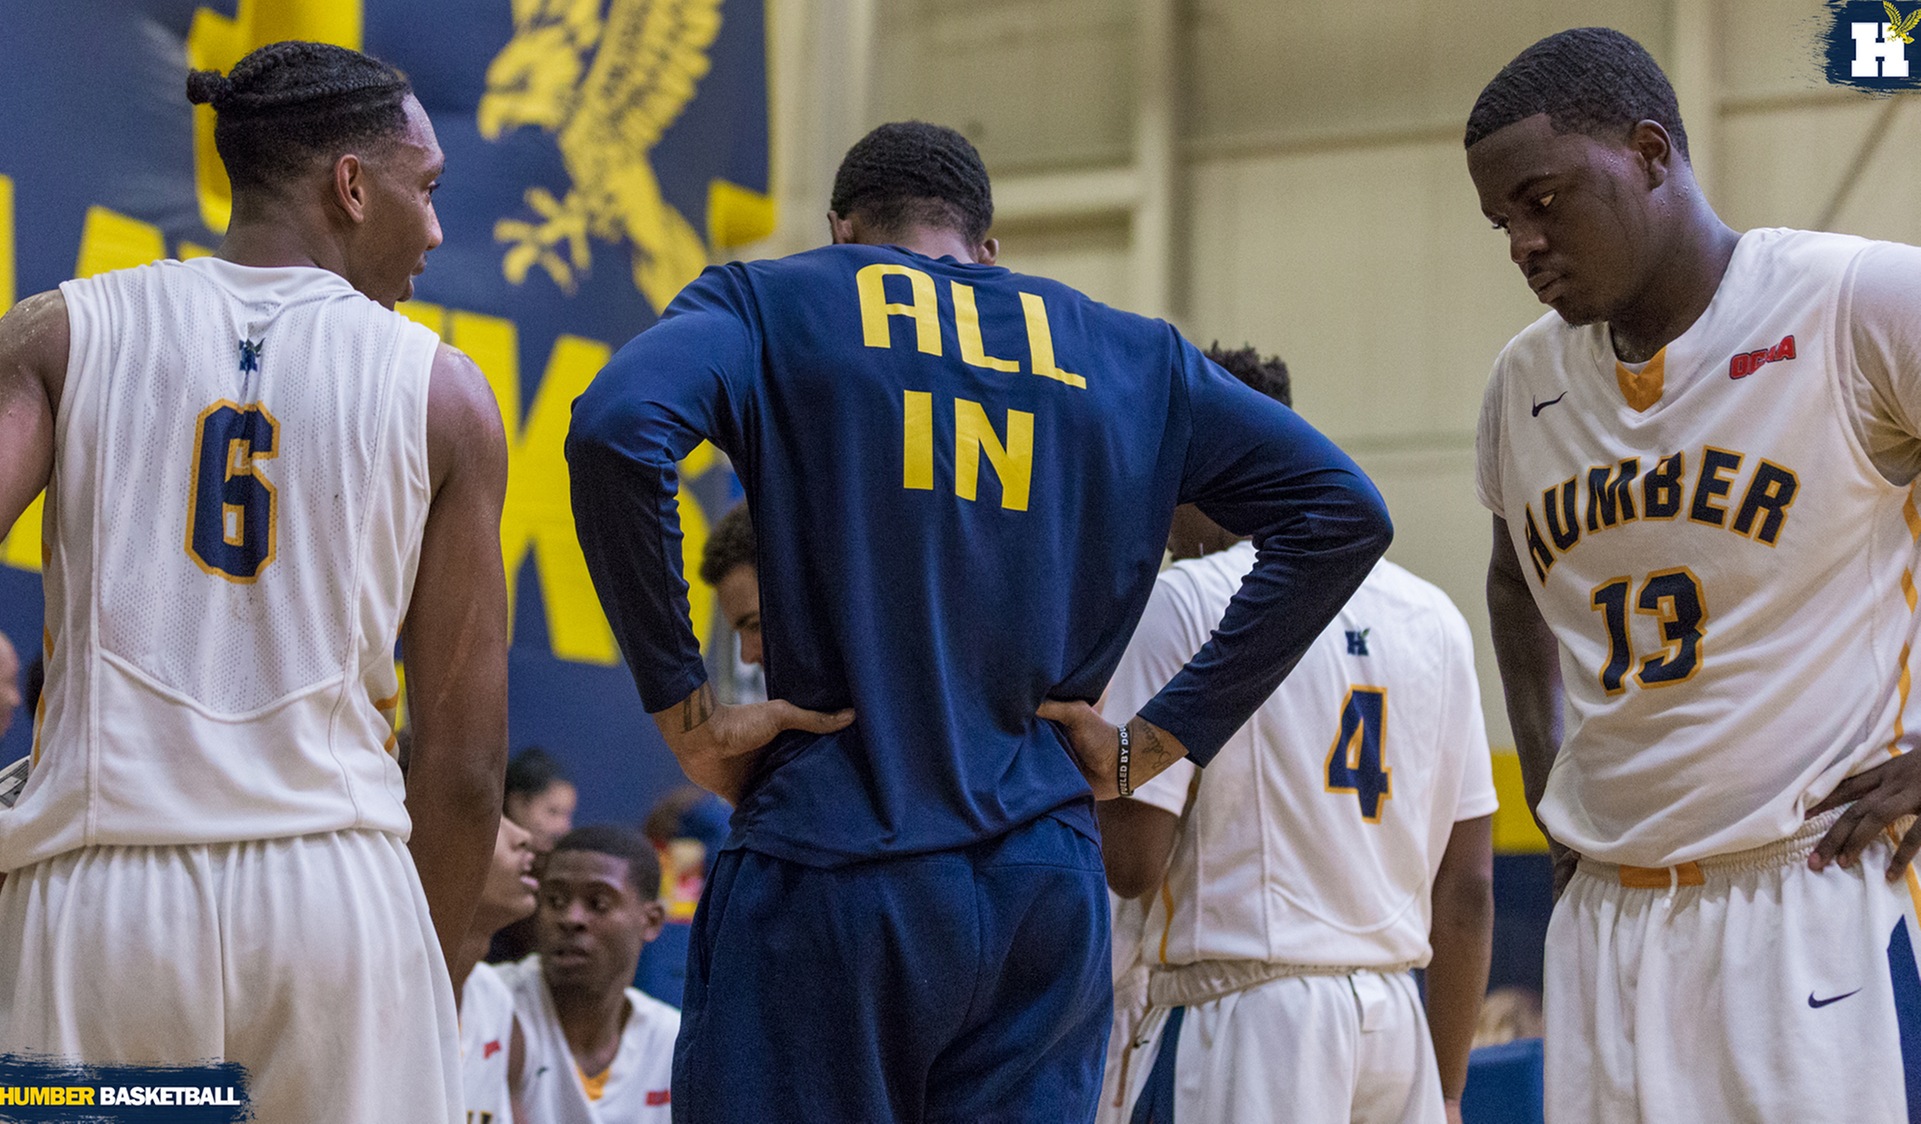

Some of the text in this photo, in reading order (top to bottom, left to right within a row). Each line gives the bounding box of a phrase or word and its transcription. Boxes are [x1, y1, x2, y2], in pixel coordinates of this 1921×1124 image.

[855, 263, 1087, 390] ALL
[185, 398, 281, 585] 6
[903, 389, 1035, 512] IN
[1524, 445, 1801, 588] HUMBER
[1590, 565, 1709, 697] 13
[1120, 747, 1129, 763] BY
[1323, 684, 1393, 824] 4
